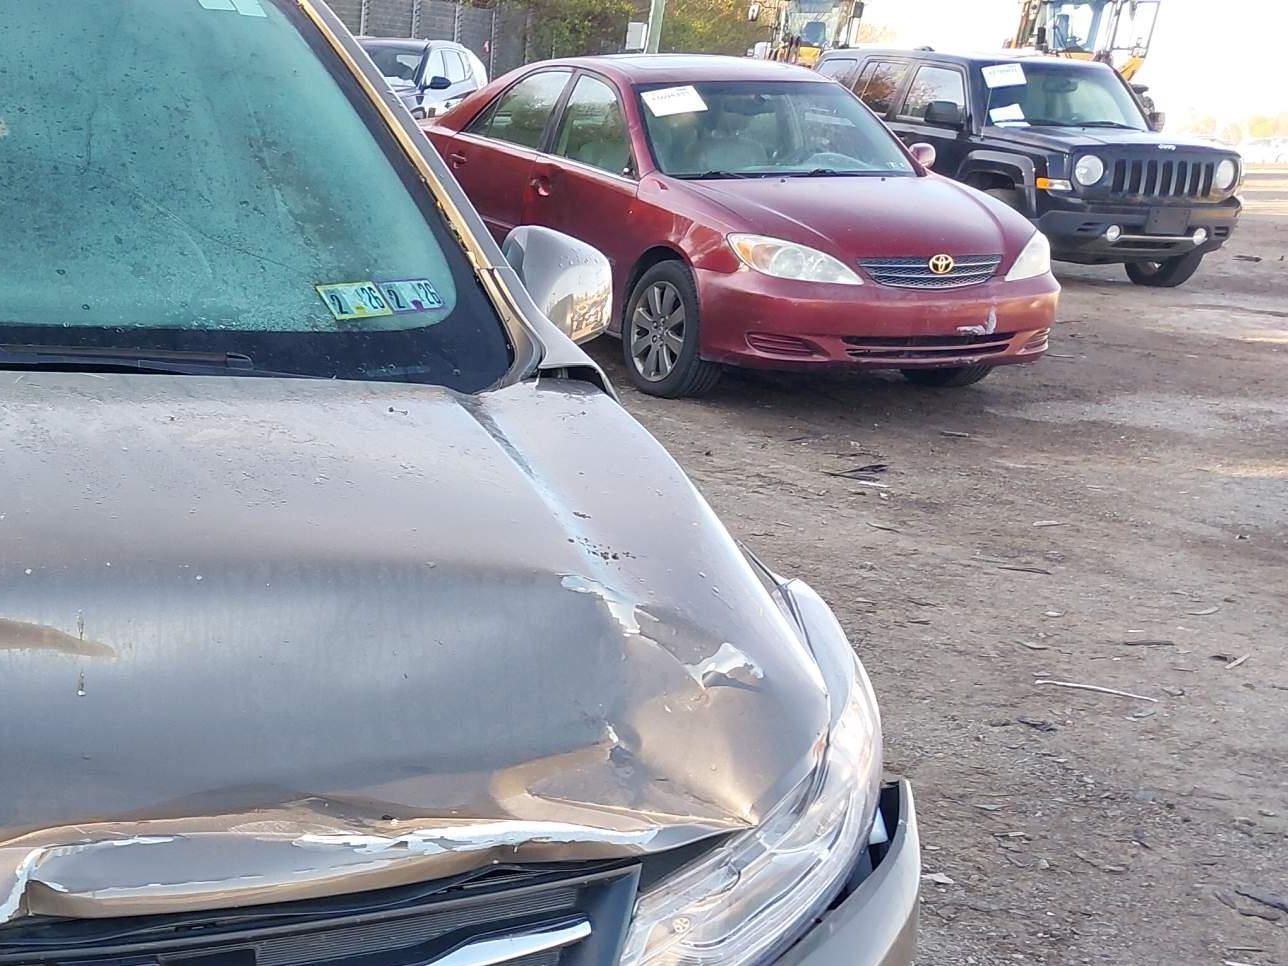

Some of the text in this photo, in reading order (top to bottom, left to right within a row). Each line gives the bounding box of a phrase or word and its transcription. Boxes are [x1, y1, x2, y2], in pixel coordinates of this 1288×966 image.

[329, 286, 385, 315] 2 26
[388, 282, 442, 309] 2 26
